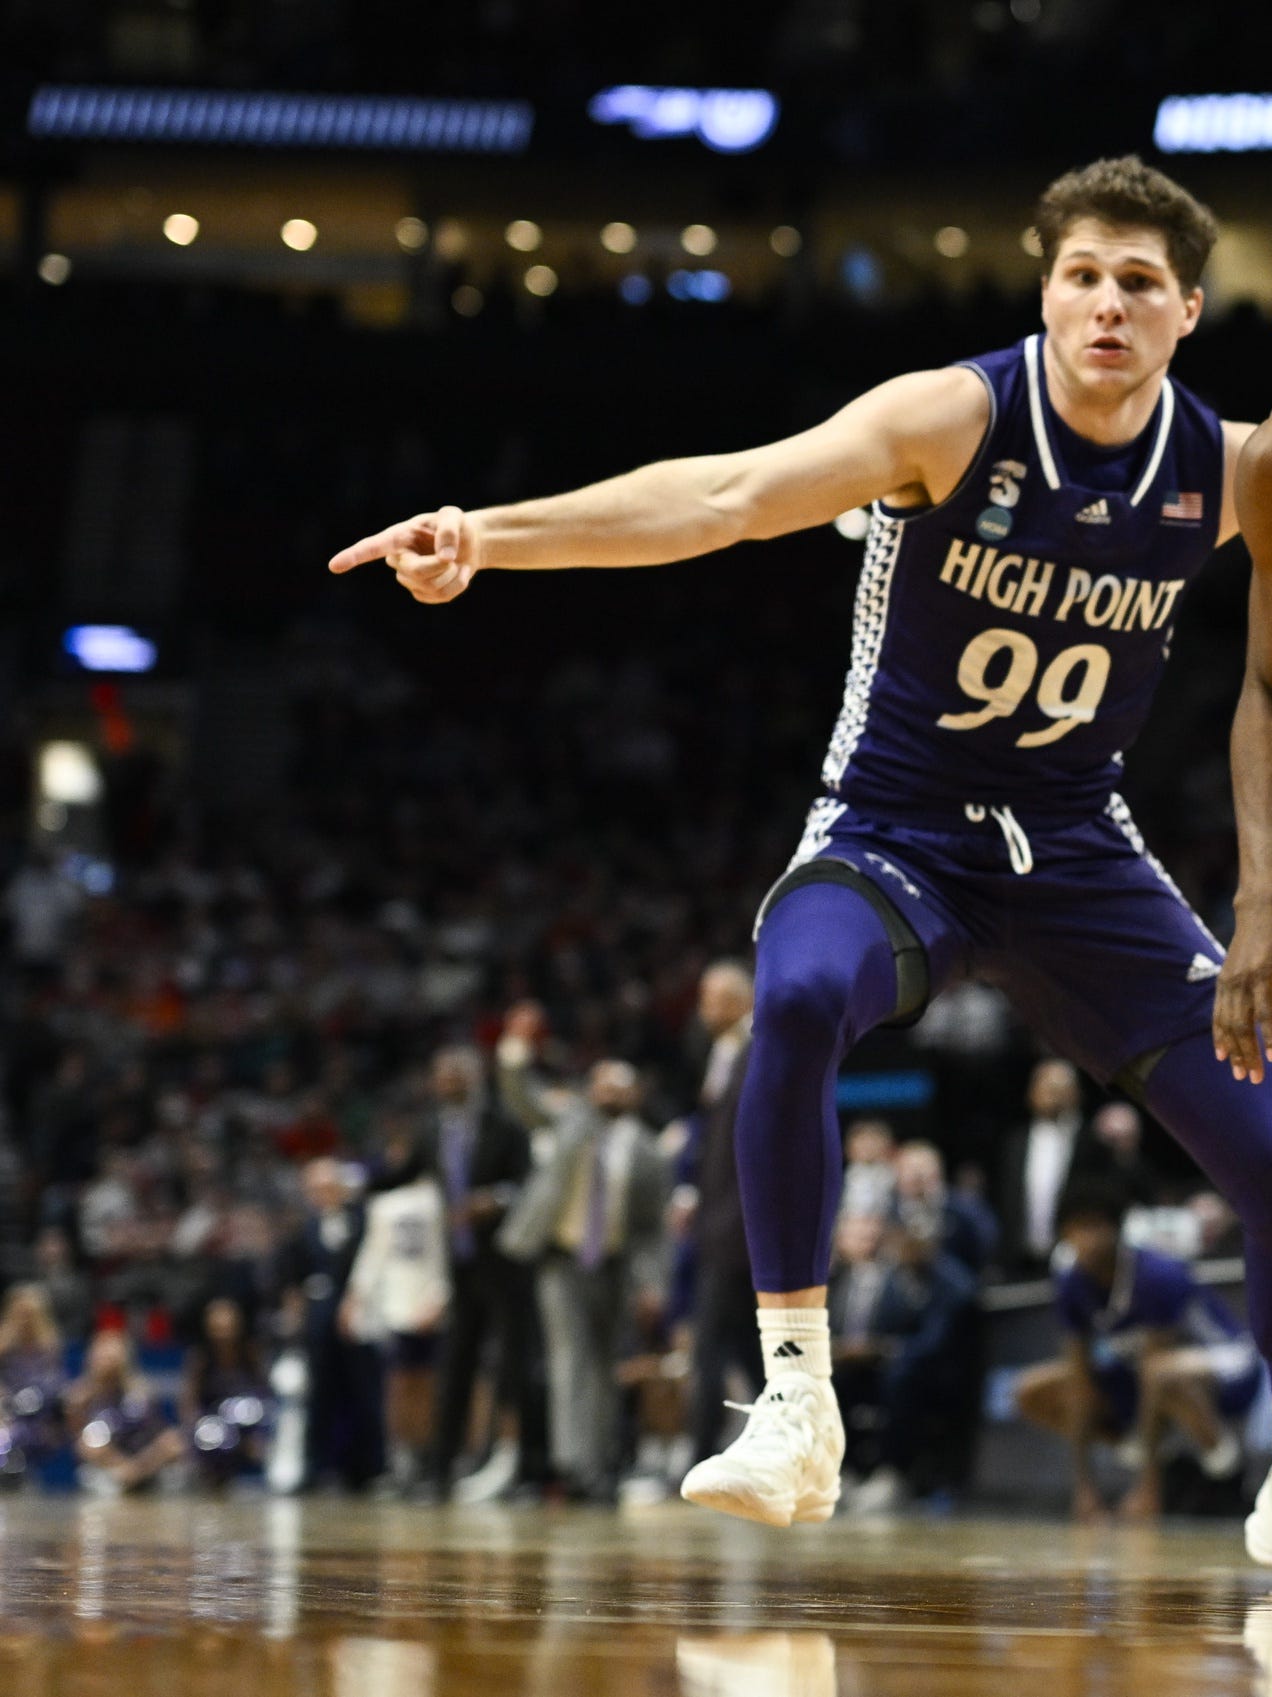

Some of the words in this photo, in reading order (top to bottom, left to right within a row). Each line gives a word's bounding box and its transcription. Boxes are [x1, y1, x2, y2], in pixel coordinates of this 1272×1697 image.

[939, 538, 1056, 617] HIGH
[1055, 567, 1186, 632] POINT
[936, 627, 1112, 748] 99
